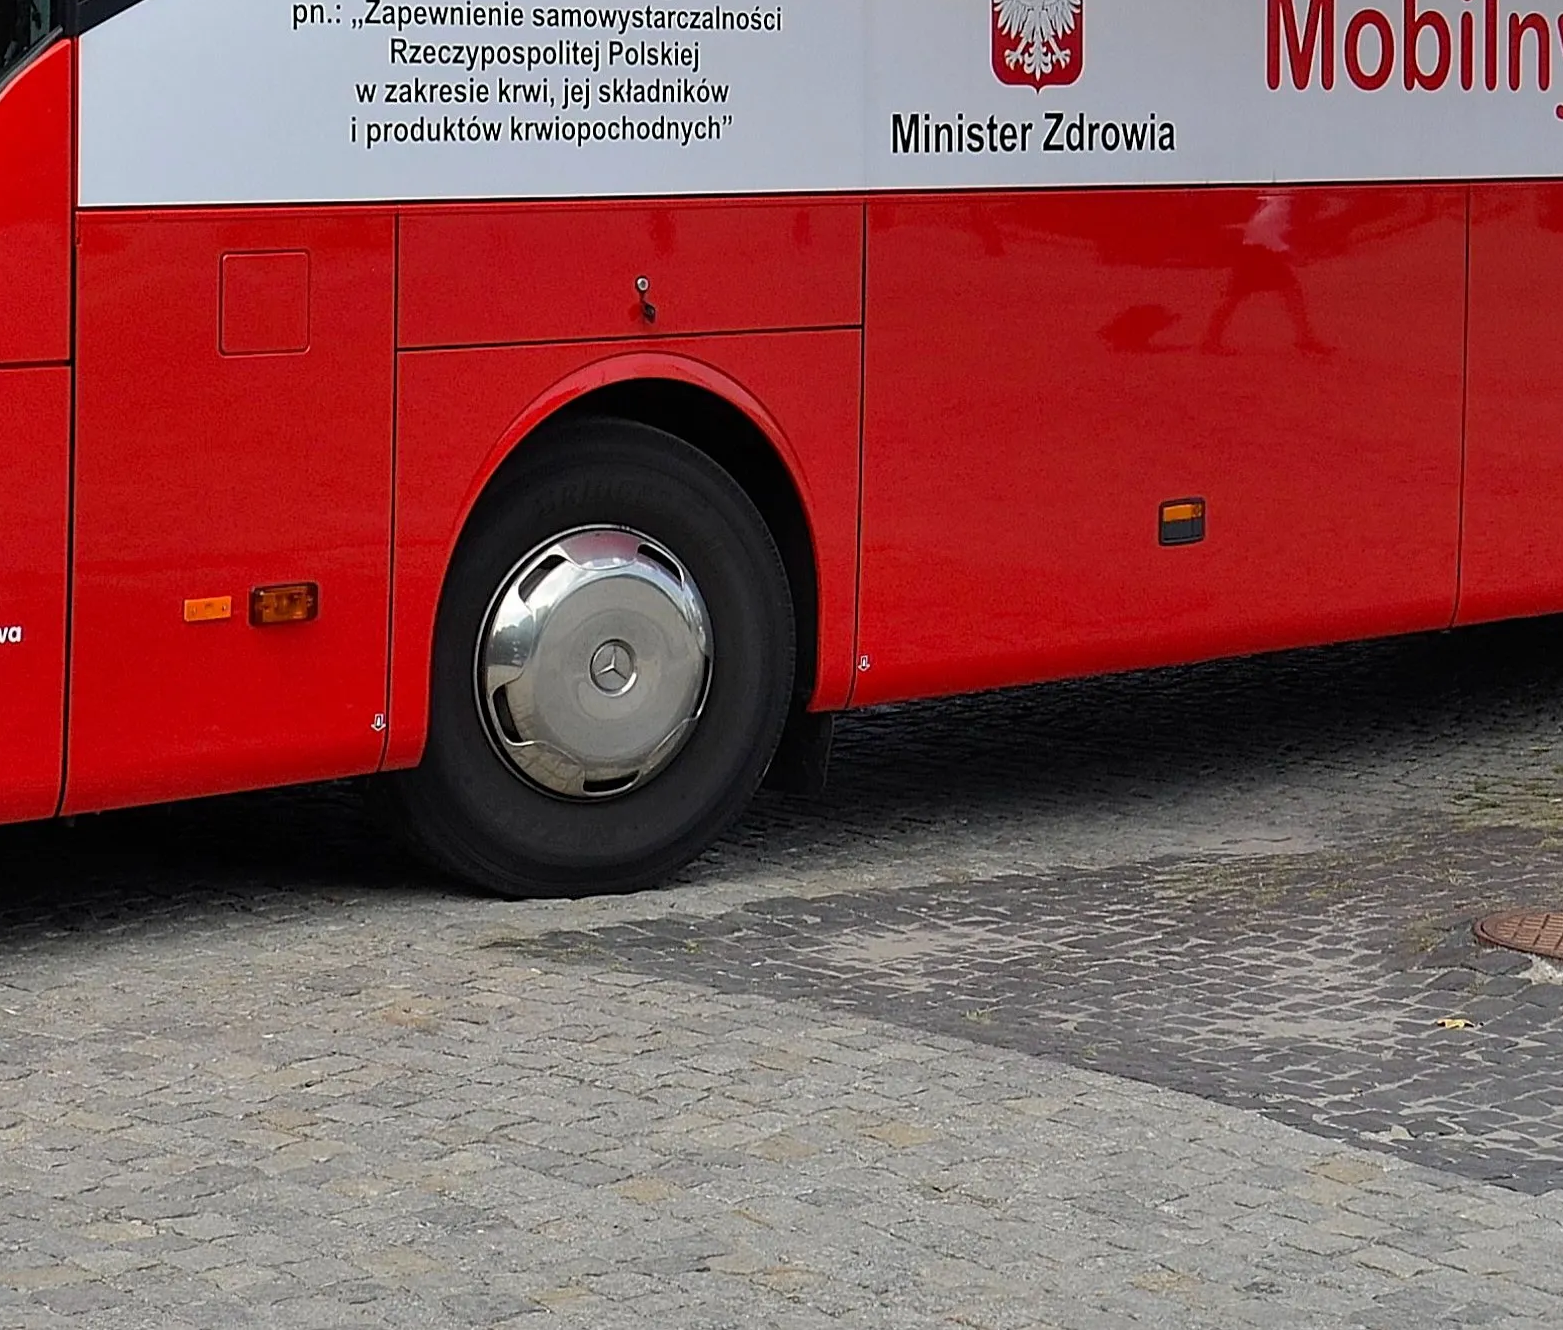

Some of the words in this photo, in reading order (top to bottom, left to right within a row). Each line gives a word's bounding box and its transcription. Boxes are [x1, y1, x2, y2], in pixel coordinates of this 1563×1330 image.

[292, 4, 342, 30] pn.:
[531, 1, 782, 34] samowystarczalności
[390, 38, 602, 71] Rzeczypospolitej
[608, 39, 701, 72] Polskiej
[355, 83, 376, 104] w
[384, 78, 490, 104] zakresie
[498, 78, 556, 109] krwi,
[561, 79, 591, 110] jej
[597, 77, 730, 104] składników
[350, 117, 358, 143] i
[366, 115, 502, 150] produktów
[891, 112, 1034, 153] Minister
[1042, 112, 1176, 152] Zdrowia
